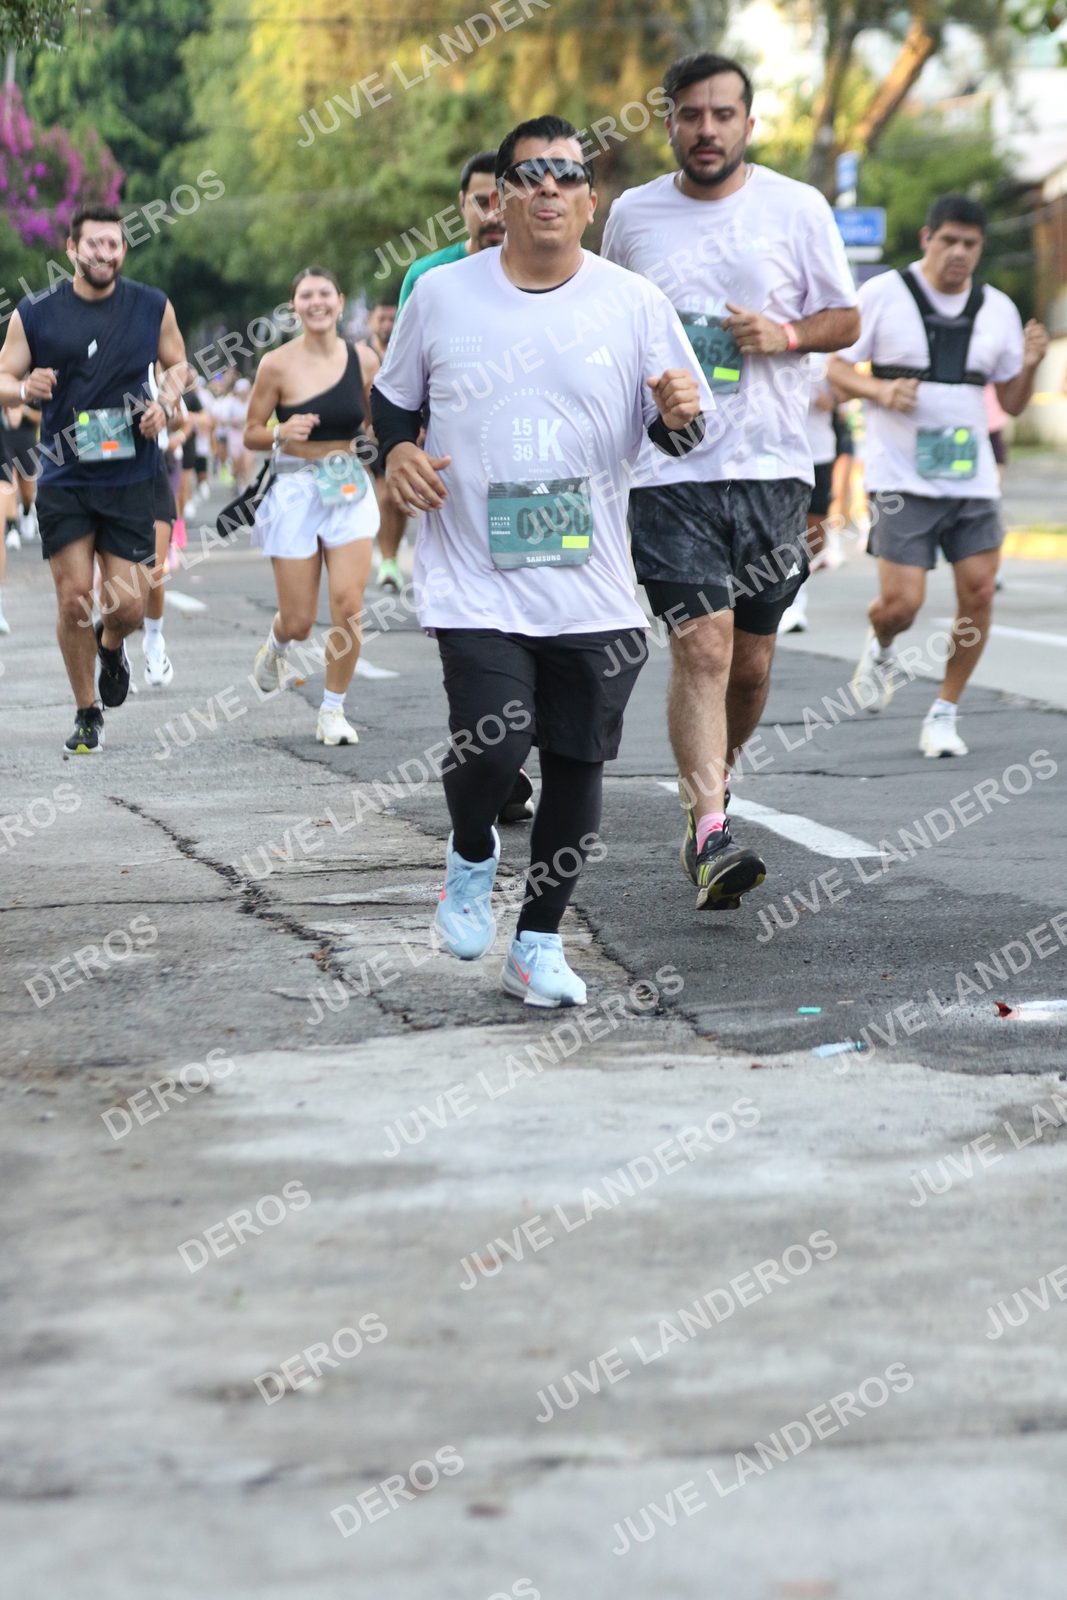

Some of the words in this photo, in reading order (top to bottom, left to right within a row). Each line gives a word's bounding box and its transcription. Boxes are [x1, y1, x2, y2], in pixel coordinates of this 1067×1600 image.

[512, 417, 533, 436] 15
[538, 418, 565, 462] K
[526, 554, 561, 563] SAMSUNG
